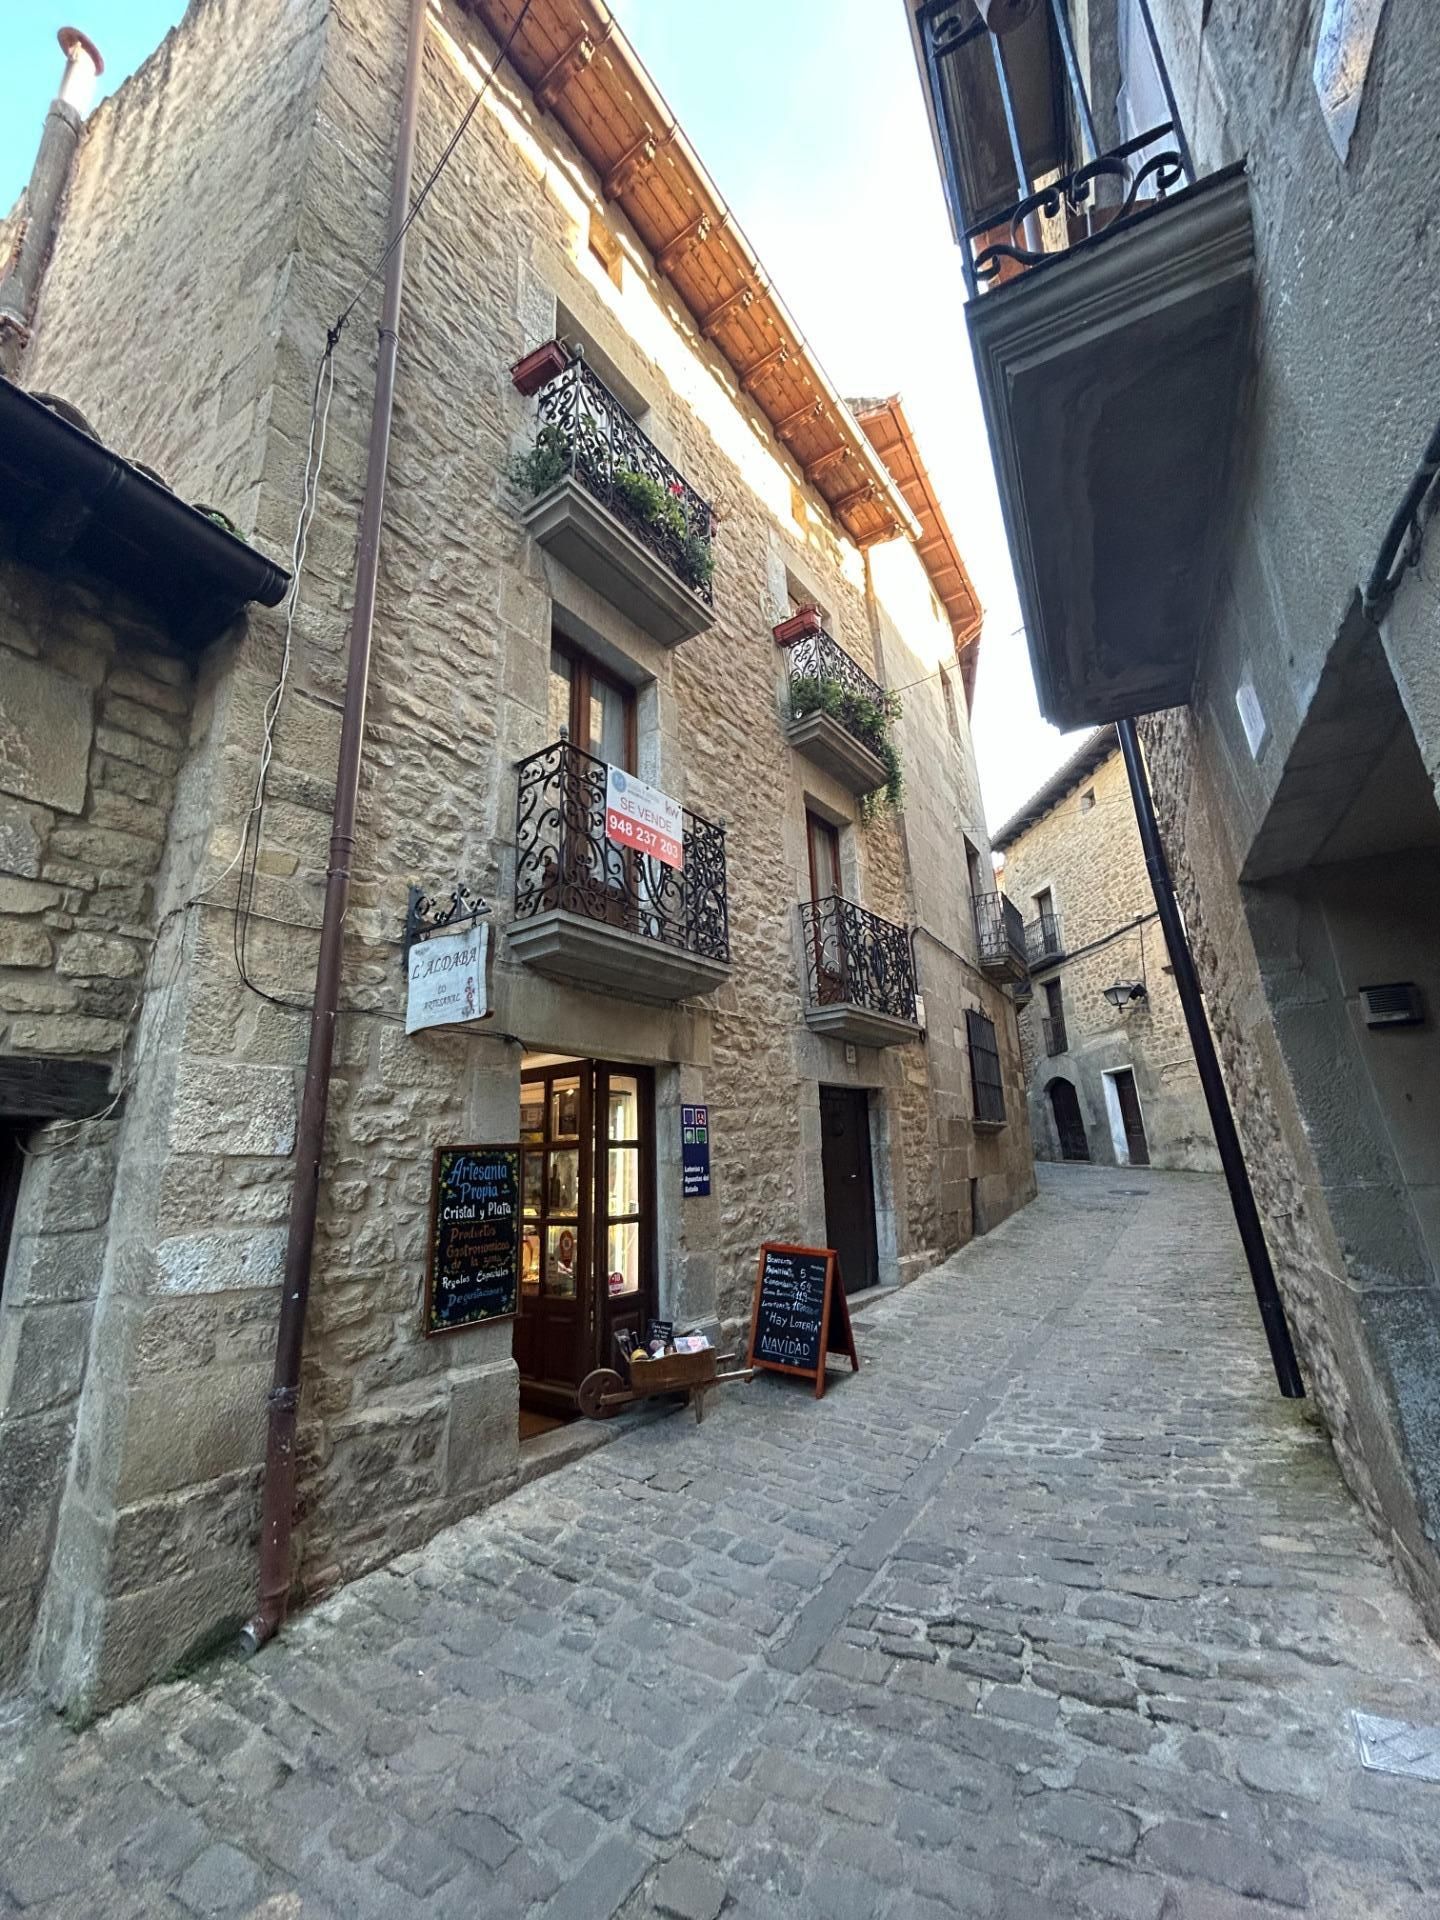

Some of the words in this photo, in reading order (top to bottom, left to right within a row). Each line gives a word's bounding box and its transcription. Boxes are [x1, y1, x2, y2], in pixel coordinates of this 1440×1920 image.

[620, 796, 635, 815] SE
[638, 805, 673, 832] VENDE
[609, 815, 633, 837] 948
[636, 827, 657, 847] 237
[660, 838, 679, 859] 203
[460, 1182, 499, 1203] Propia
[443, 1204, 475, 1220] Cristal
[479, 1208, 485, 1220] y
[487, 1201, 512, 1216] Plata
[442, 1275, 470, 1290] Regalos
